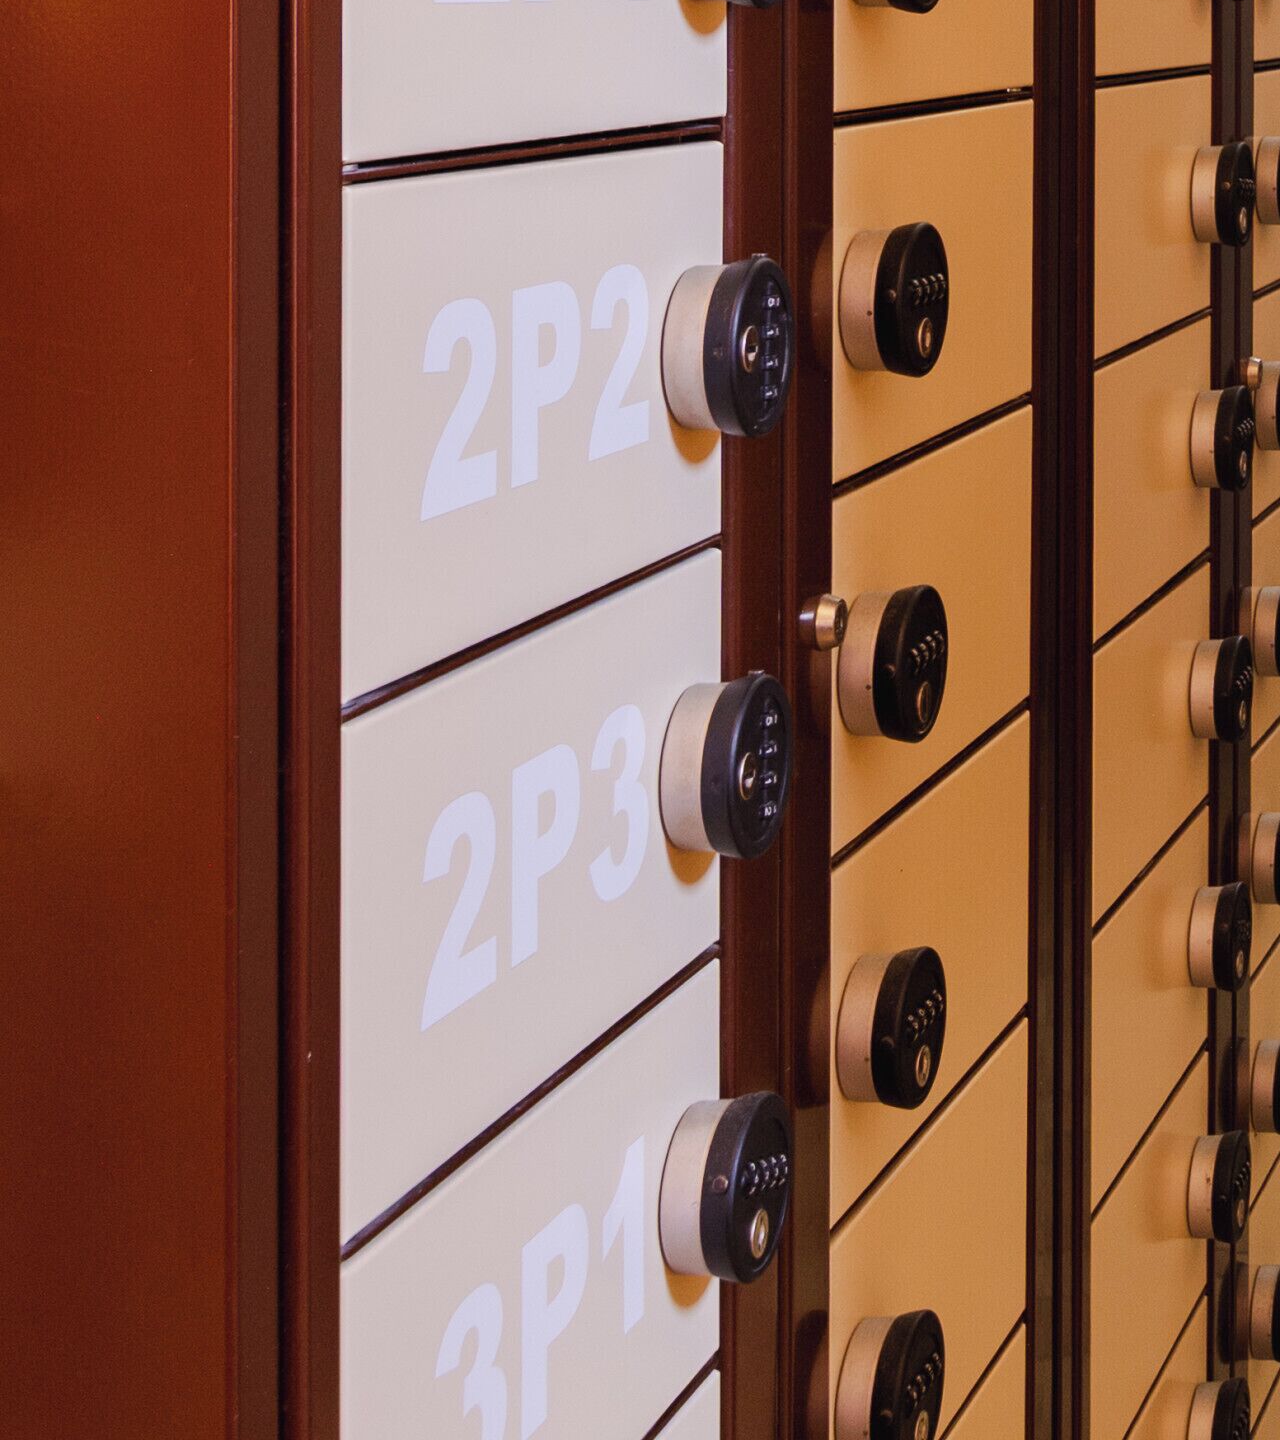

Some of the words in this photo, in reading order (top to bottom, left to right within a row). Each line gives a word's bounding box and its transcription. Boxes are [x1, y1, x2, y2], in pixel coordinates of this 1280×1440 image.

[420, 263, 650, 522] 2P2
[420, 703, 650, 1033] 2P3
[435, 1134, 645, 1440] 3P1
